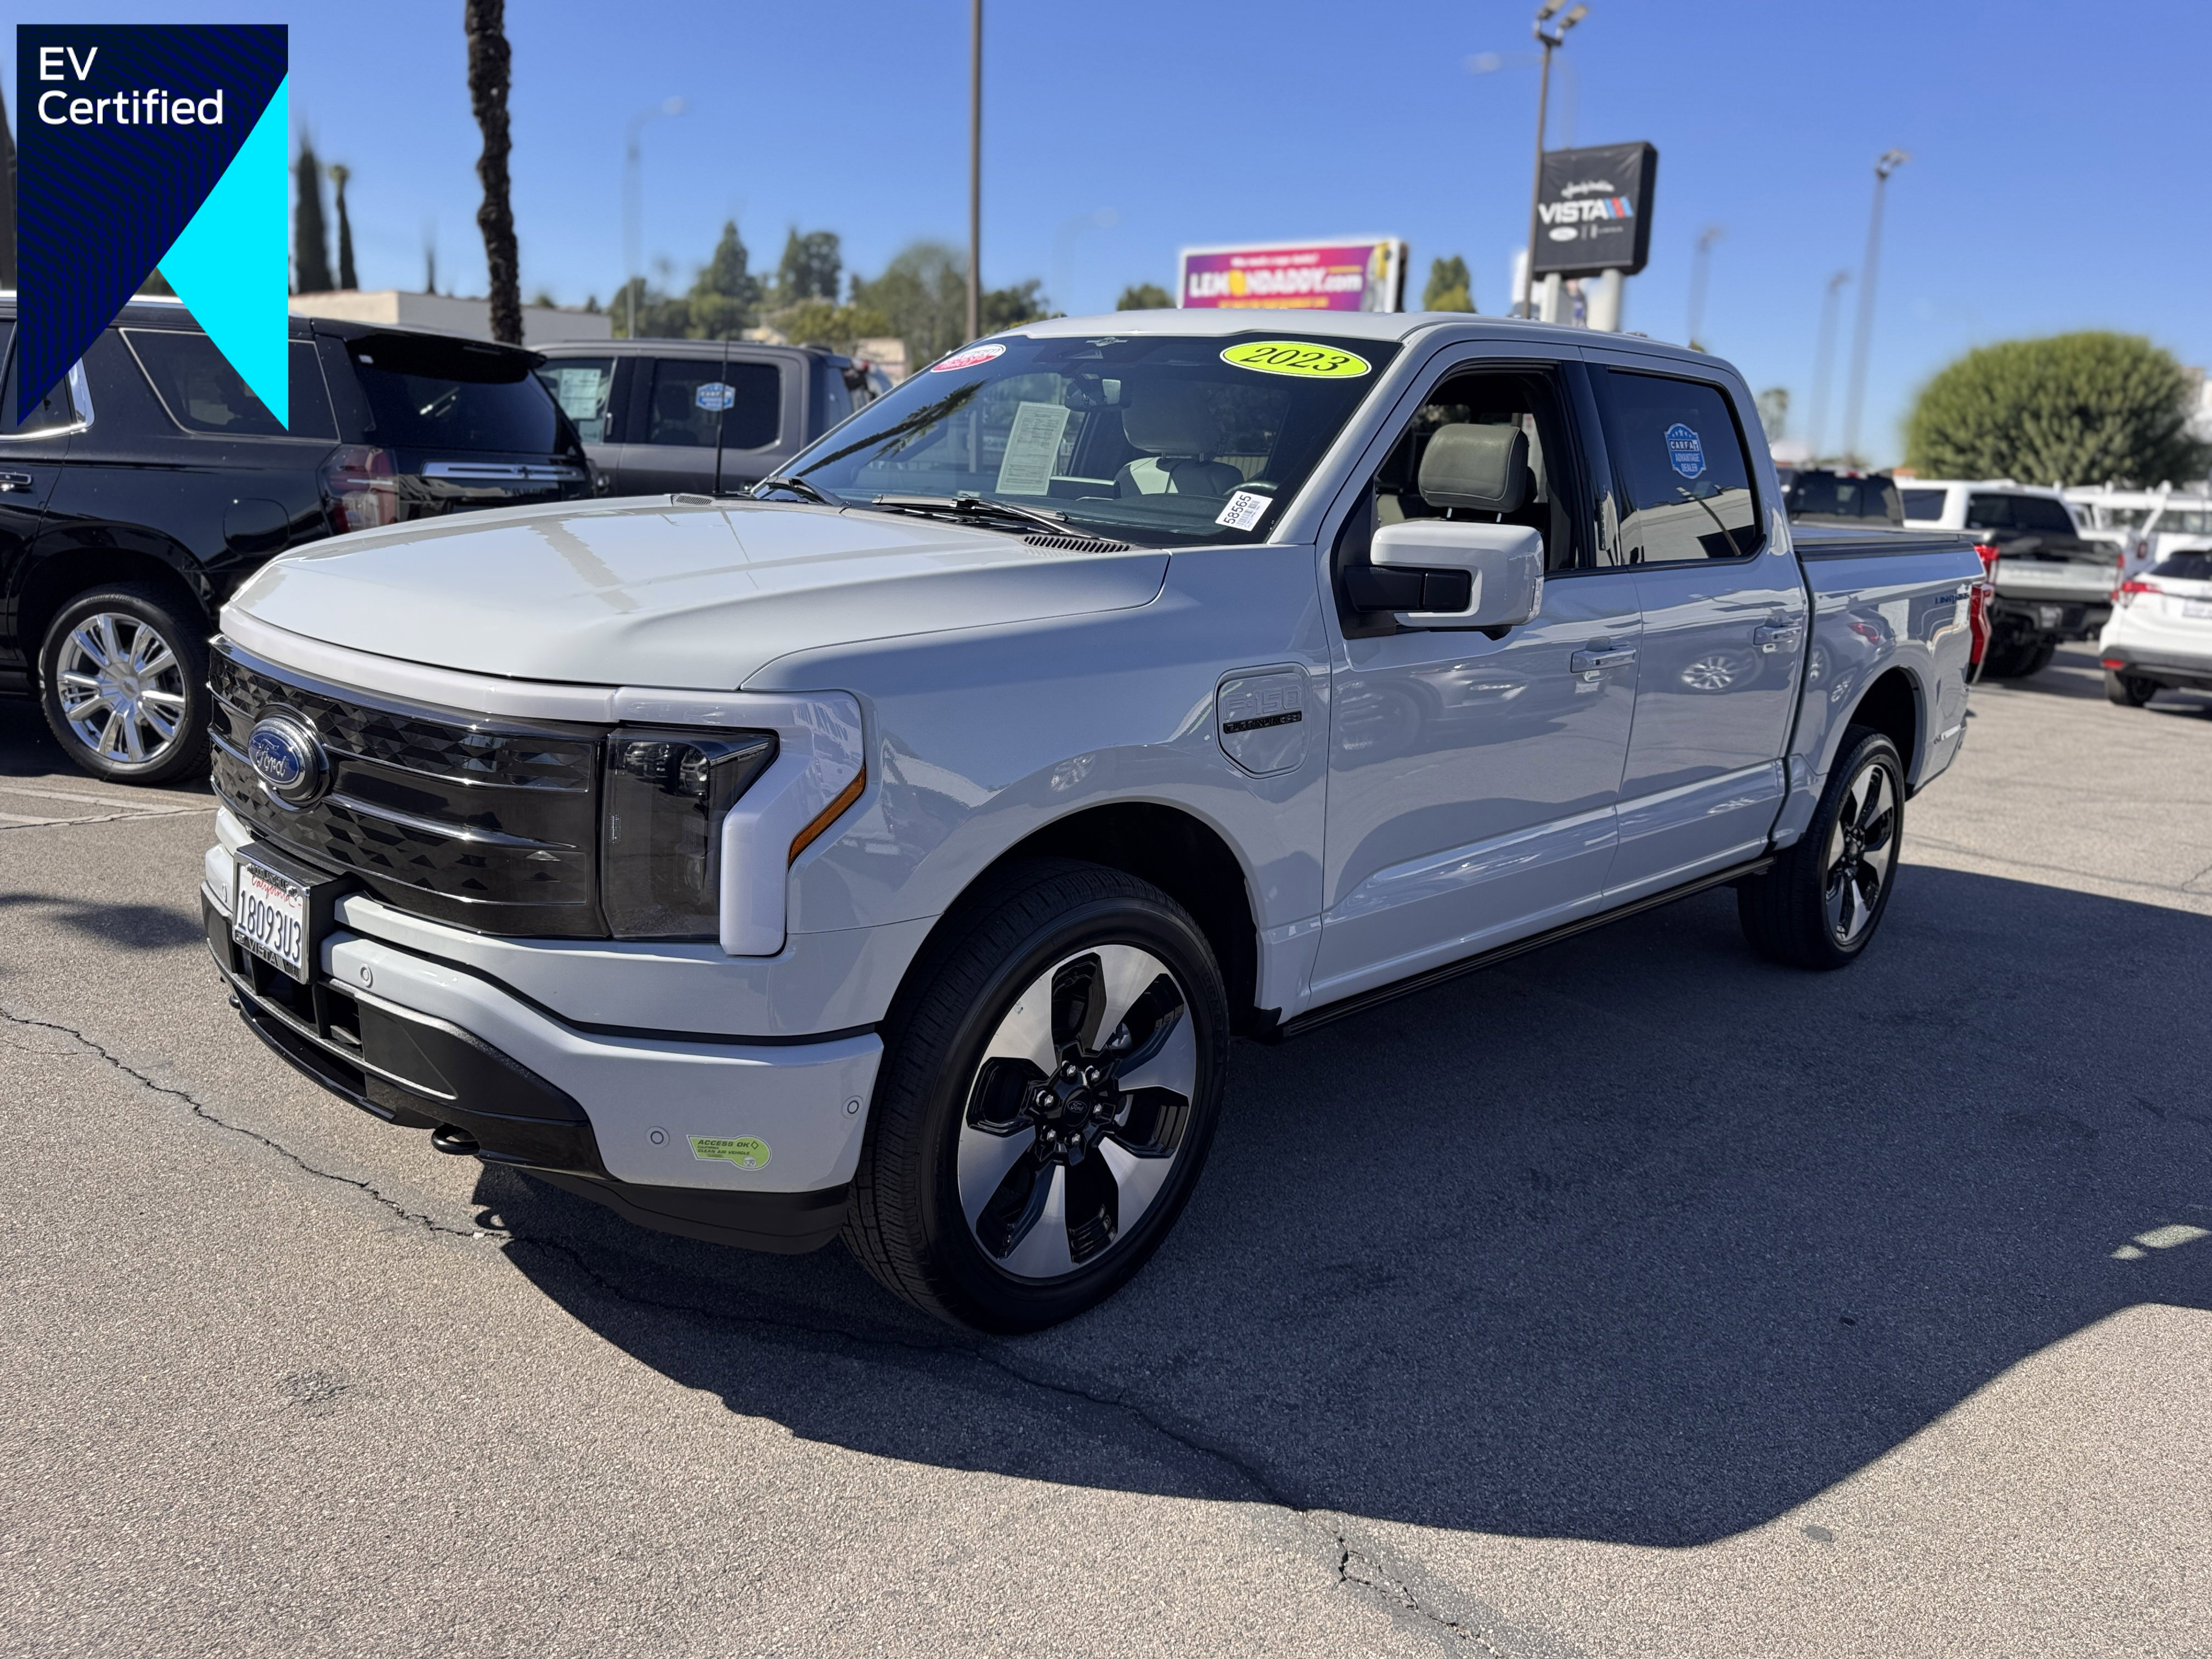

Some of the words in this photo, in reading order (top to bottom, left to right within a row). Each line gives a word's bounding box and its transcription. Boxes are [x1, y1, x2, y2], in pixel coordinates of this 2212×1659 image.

[1538, 199, 1609, 225] VISTA
[1239, 347, 1351, 371] 2023
[1670, 440, 1700, 450] CARFAX
[1223, 495, 1252, 524] 58565
[1221, 685, 1302, 720] F-150
[253, 738, 286, 777] Ford
[251, 876, 295, 908] California
[238, 889, 301, 962] 18093U3
[1070, 1102, 1085, 1111] Ford
